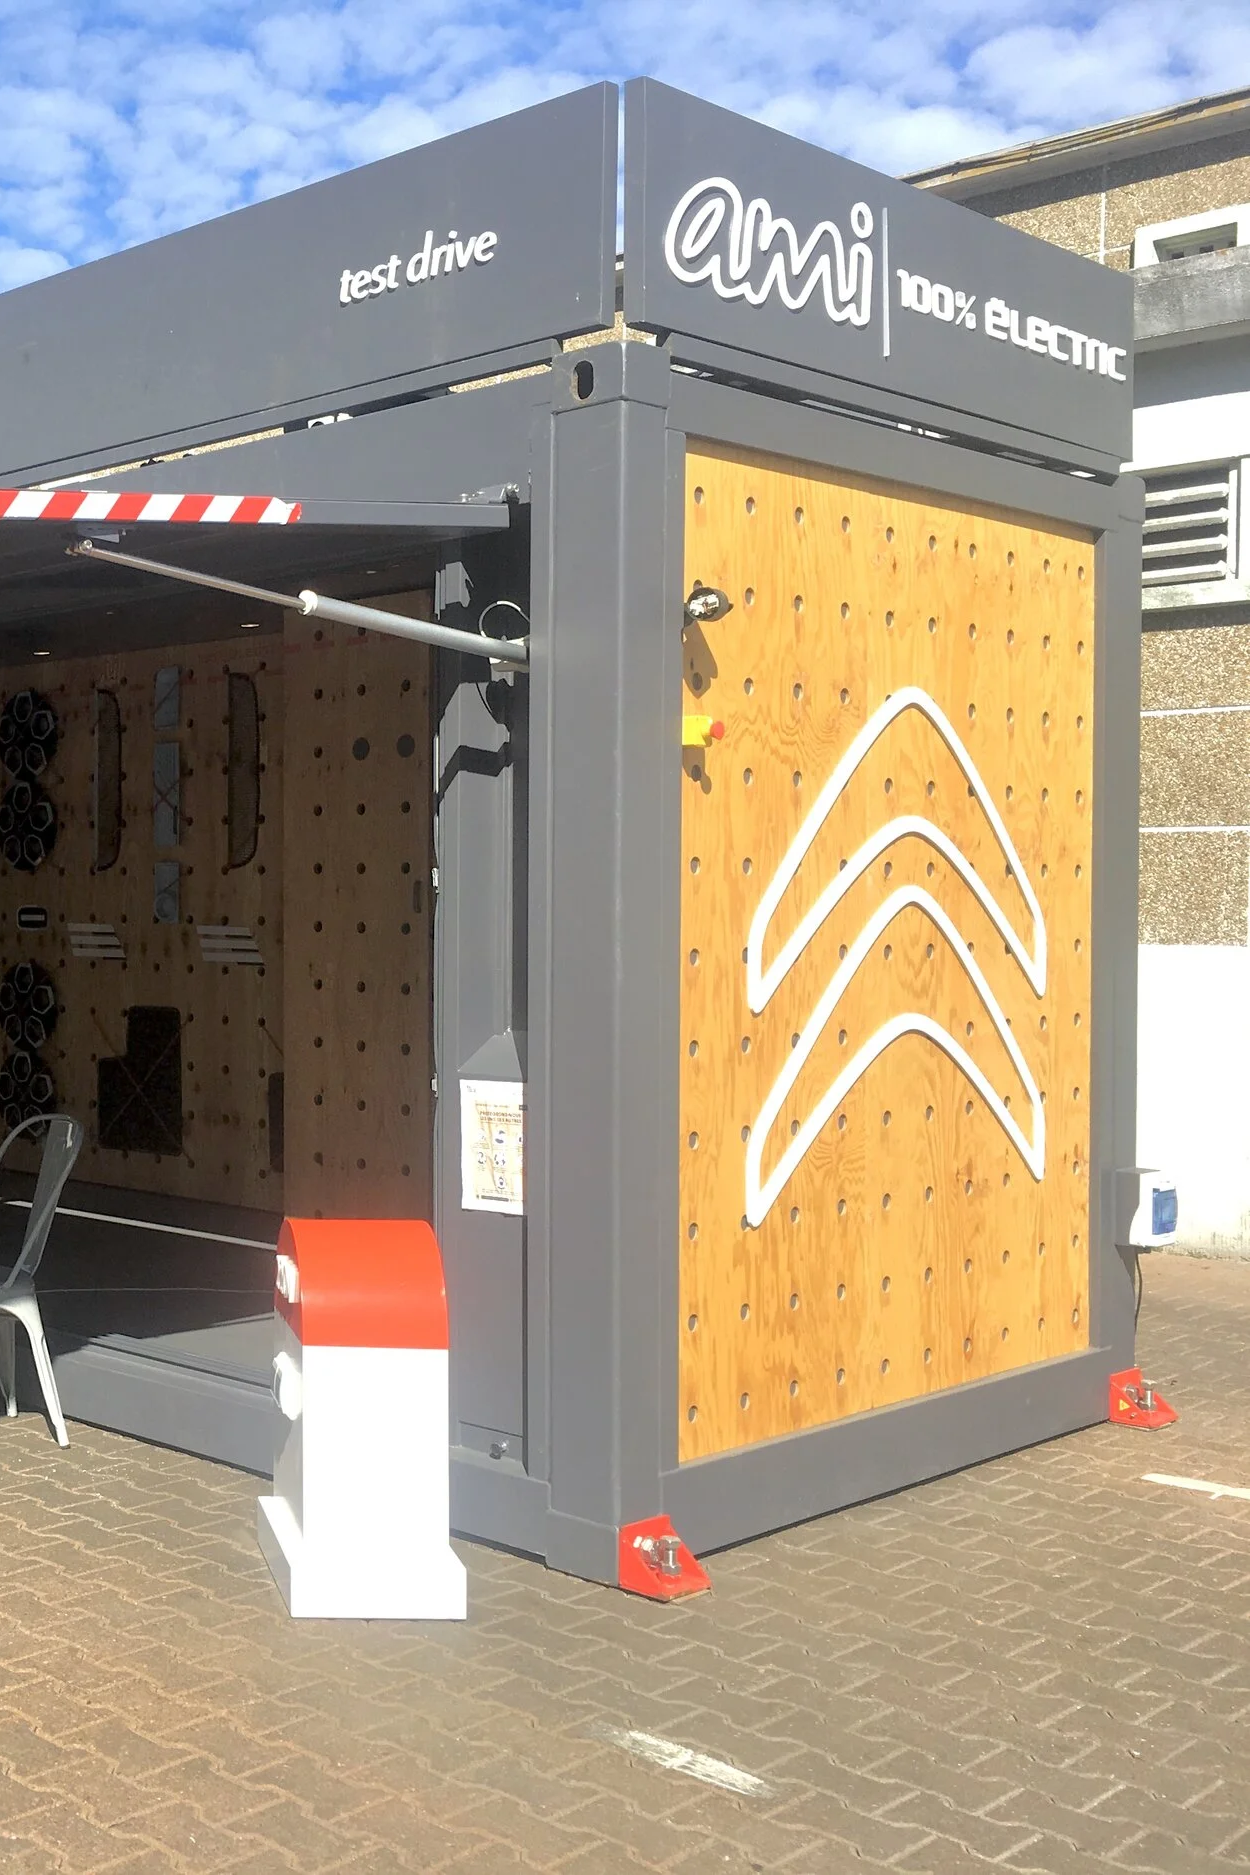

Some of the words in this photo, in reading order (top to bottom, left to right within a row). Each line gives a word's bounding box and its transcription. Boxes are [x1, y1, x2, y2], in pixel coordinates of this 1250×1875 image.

[340, 255, 401, 303] test
[406, 230, 498, 283] drive
[664, 176, 873, 326] ami
[896, 268, 977, 330] 100%
